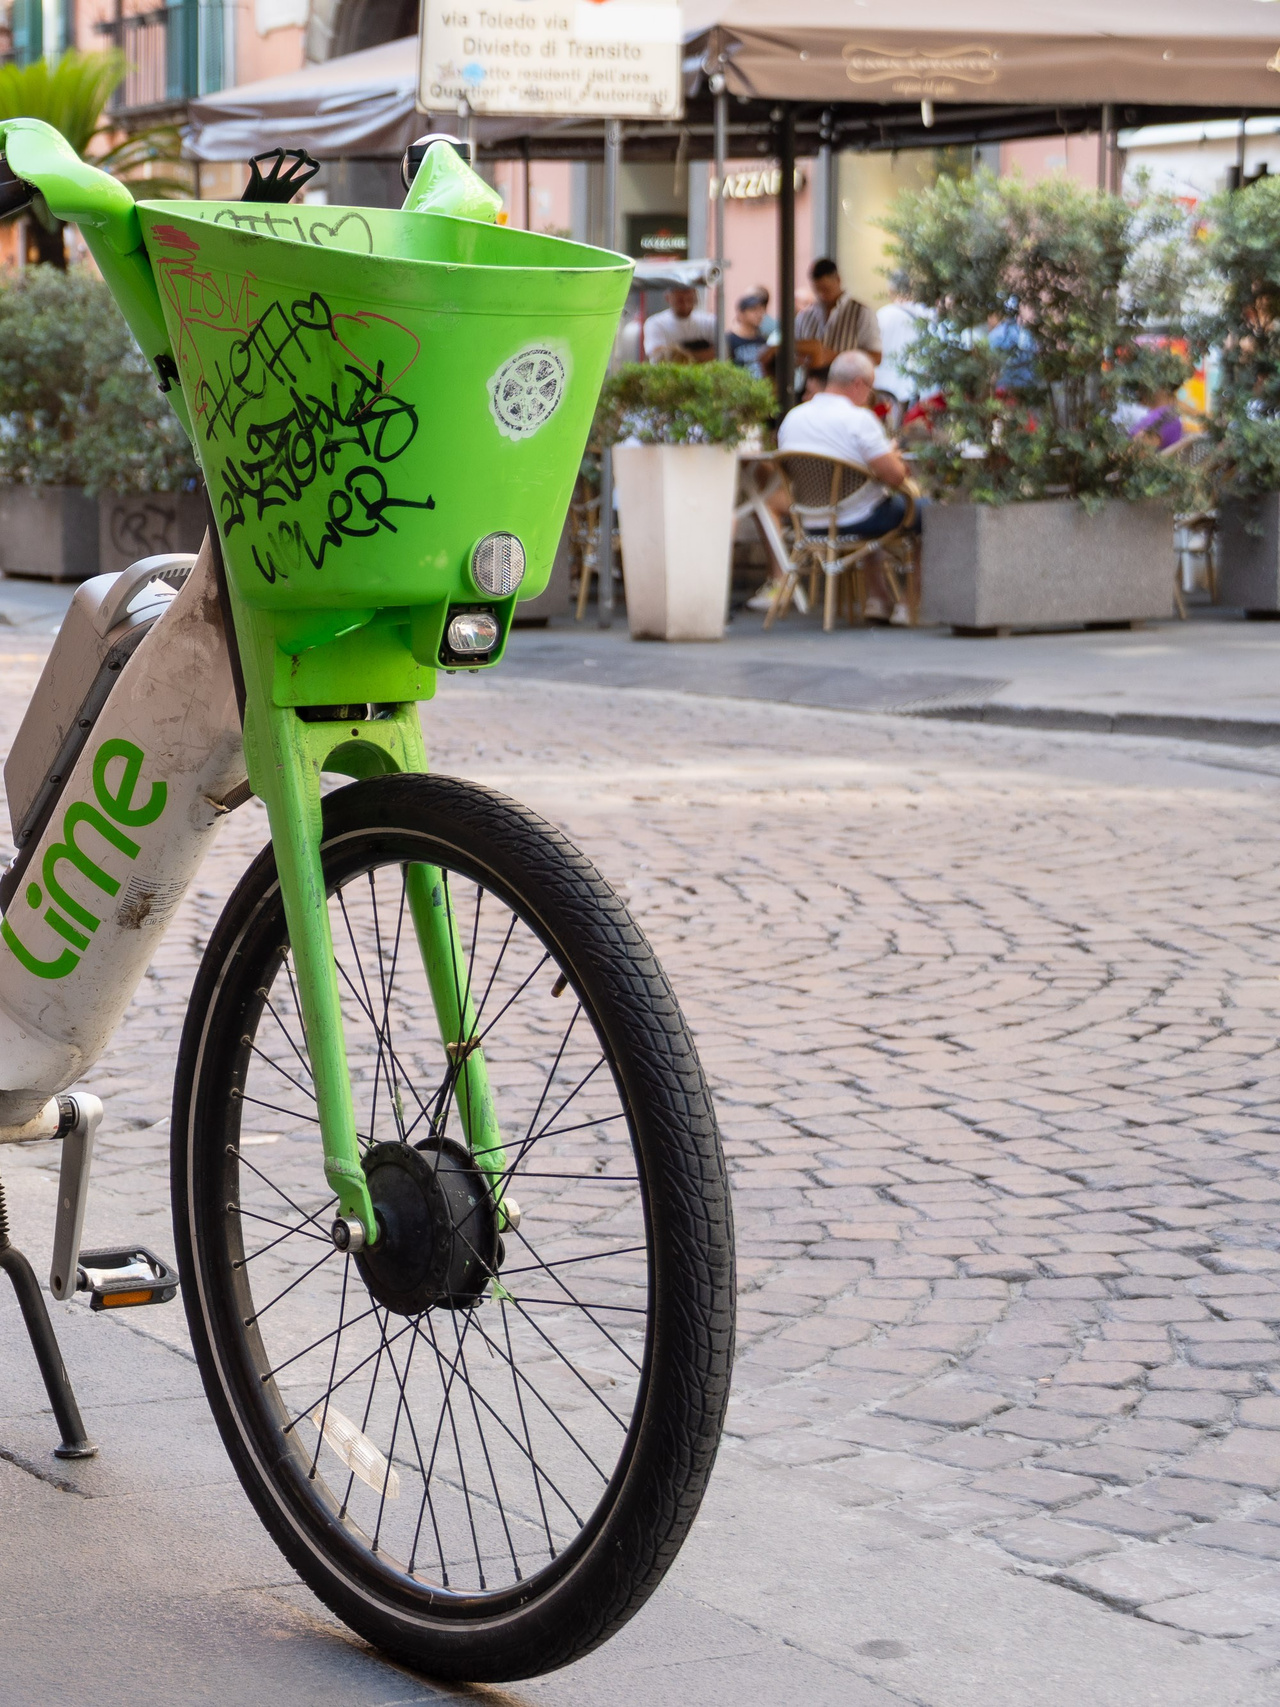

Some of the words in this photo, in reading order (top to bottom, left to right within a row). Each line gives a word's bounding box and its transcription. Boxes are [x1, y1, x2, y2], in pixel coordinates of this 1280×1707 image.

[442, 11, 468, 28] via
[478, 11, 536, 30] Toledo
[543, 13, 568, 31] via
[462, 37, 531, 58] Divieto
[540, 40, 556, 60] di
[567, 40, 642, 60] Transito
[518, 67, 580, 81] residenti
[0, 738, 168, 980] Lime
